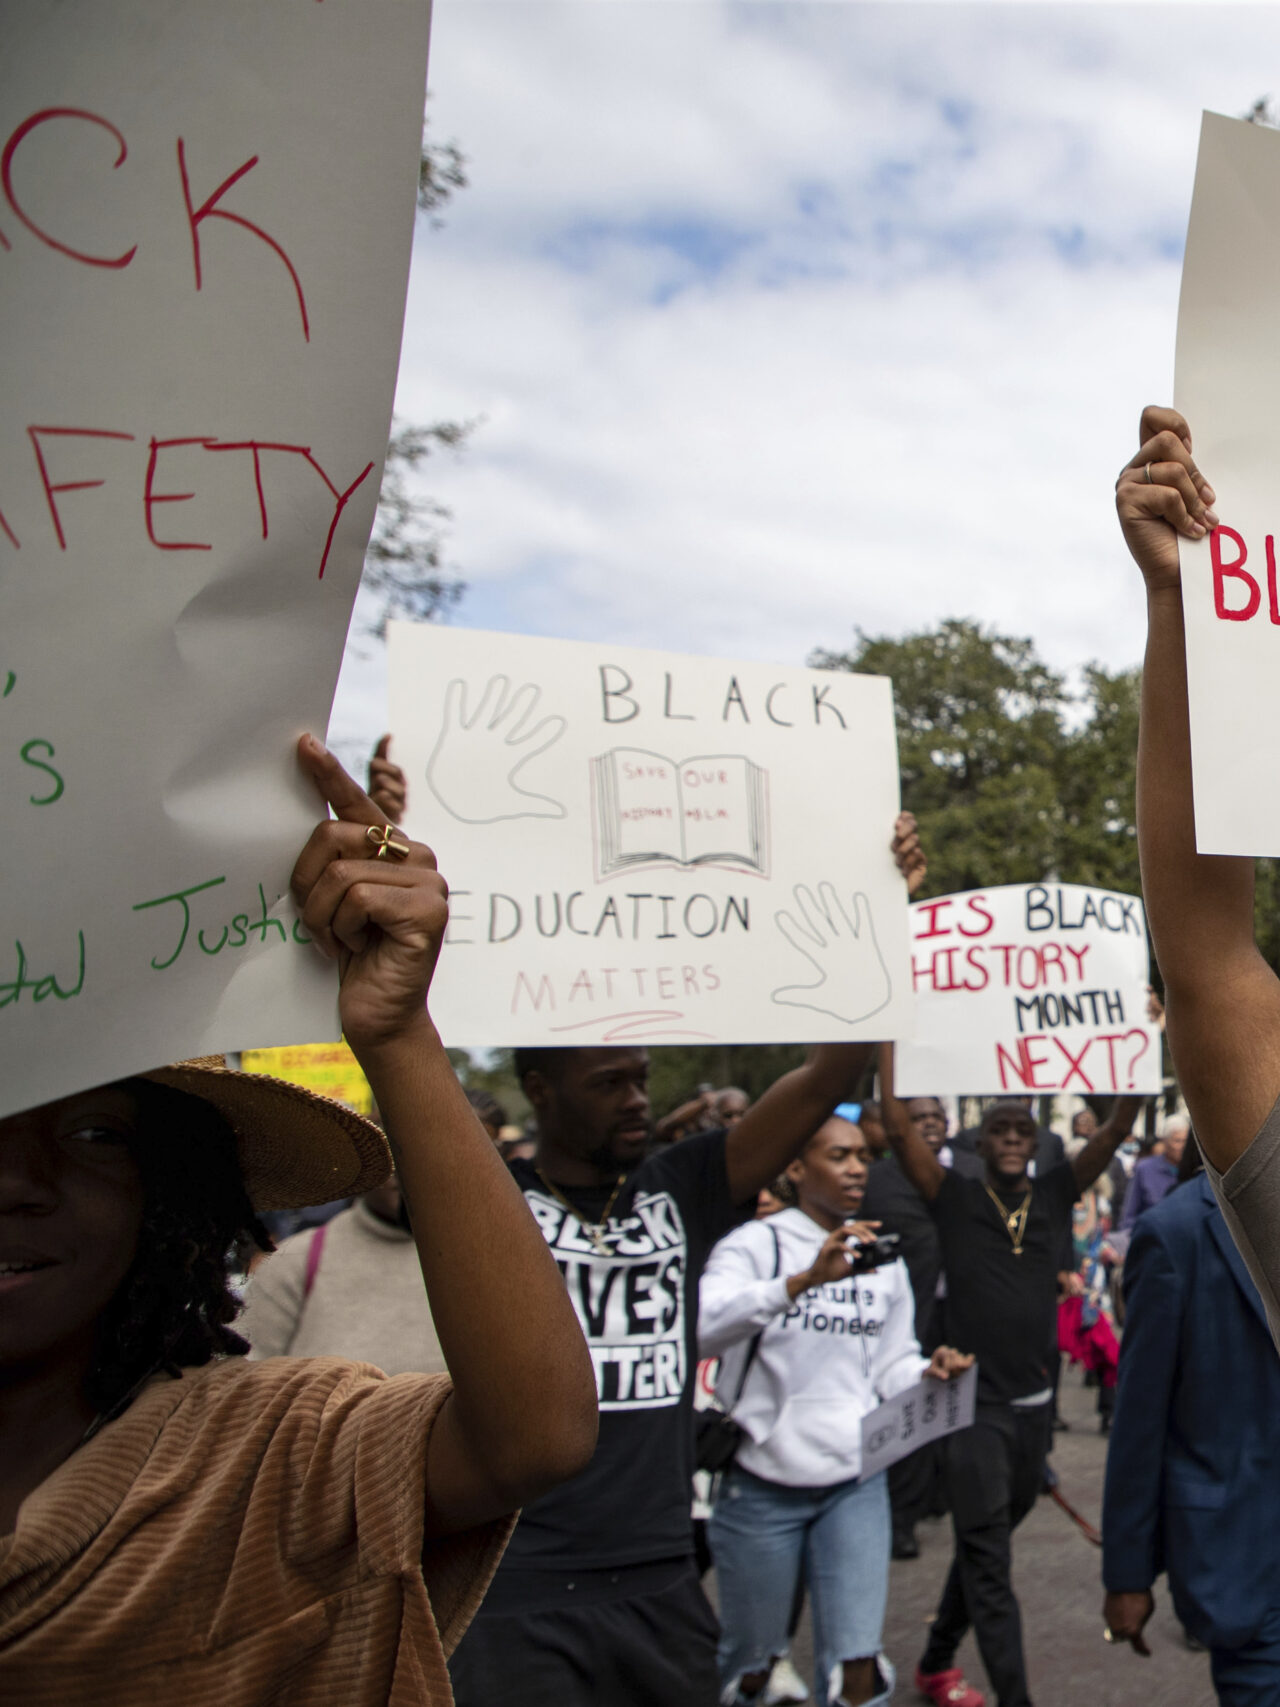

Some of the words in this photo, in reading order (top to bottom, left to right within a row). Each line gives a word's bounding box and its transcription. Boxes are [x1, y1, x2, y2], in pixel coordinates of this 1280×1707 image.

[0, 108, 310, 342] CK
[0, 426, 375, 580] FETY
[599, 664, 849, 730] BLACK
[0, 929, 86, 1009] tal
[131, 875, 313, 971] Justic
[445, 890, 750, 946] EDUCATION
[914, 895, 995, 941] IS
[1025, 885, 1142, 937] BLACK
[511, 964, 722, 1014] MATTERS
[911, 941, 1091, 994] HISTORY
[1014, 989, 1126, 1033] MONTH
[995, 1028, 1150, 1093] NEXT?
[556, 1256, 682, 1338] VES
[782, 1301, 886, 1337] Pioneer
[589, 1343, 684, 1402] TTER
